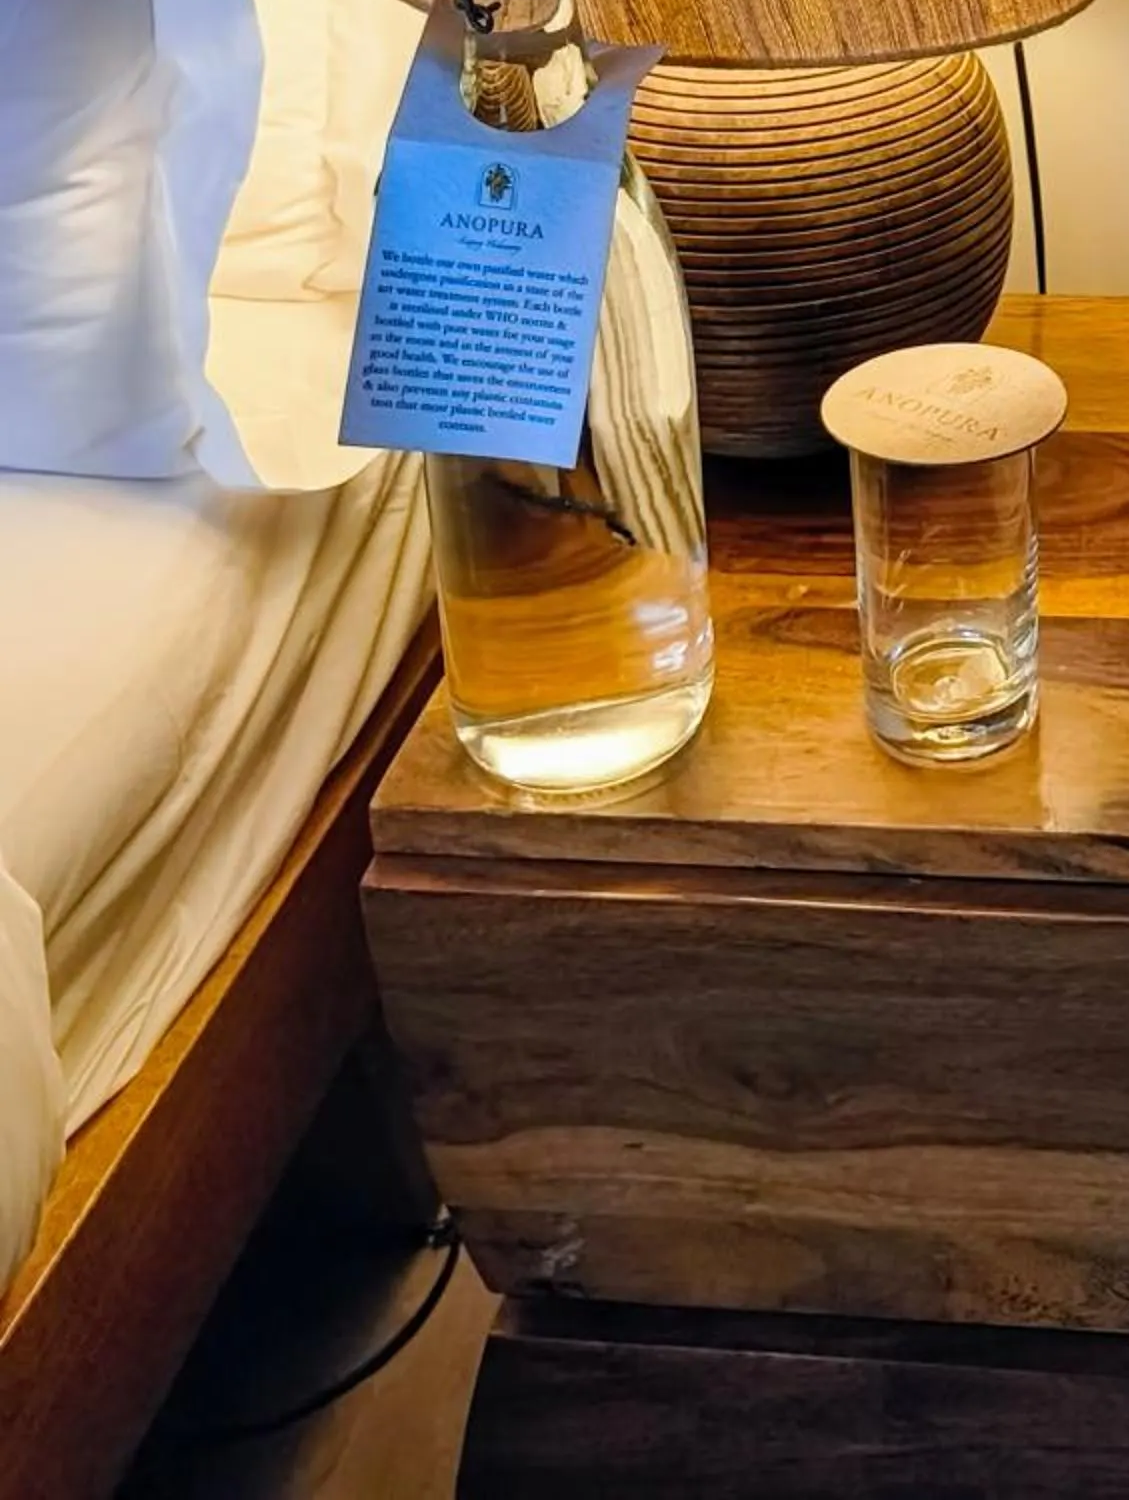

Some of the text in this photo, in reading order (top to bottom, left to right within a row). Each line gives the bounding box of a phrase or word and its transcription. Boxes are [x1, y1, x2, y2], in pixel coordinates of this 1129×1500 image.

[440, 212, 544, 239] ANOPURA
[485, 310, 519, 324] WHO
[857, 385, 999, 442] ANOPURA
